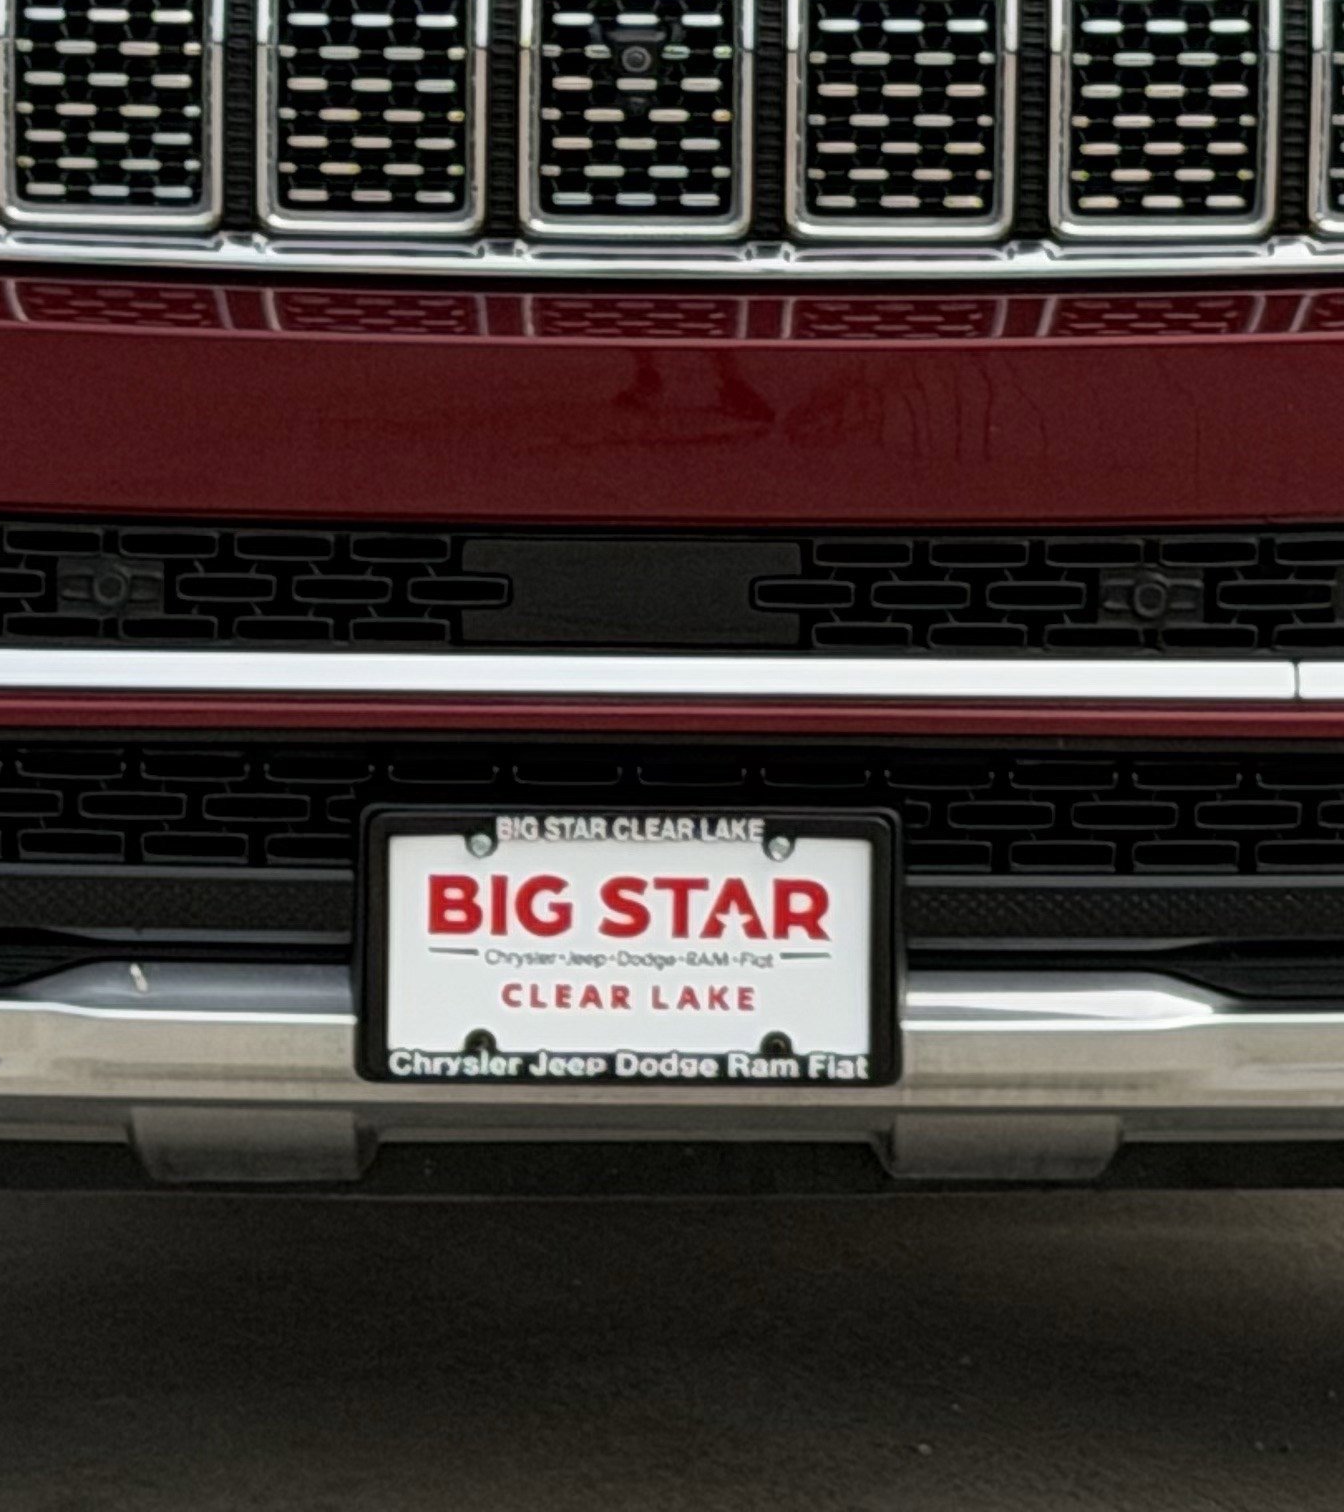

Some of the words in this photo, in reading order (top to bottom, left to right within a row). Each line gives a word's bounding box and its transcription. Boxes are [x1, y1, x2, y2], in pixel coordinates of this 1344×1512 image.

[496, 816, 539, 840] BIG
[544, 816, 607, 841] STAR
[612, 817, 694, 842] CLEAR
[700, 818, 765, 843] LAKE
[427, 874, 573, 937] BIG
[598, 876, 832, 941] STAR
[501, 983, 632, 1010] CLEAR
[652, 985, 756, 1011] LAKE
[388, 1050, 523, 1077] Chrysler
[529, 1051, 608, 1077] Jeep
[615, 1052, 719, 1078] Dodge
[727, 1052, 800, 1078] Ram
[808, 1054, 869, 1080] Fiat
